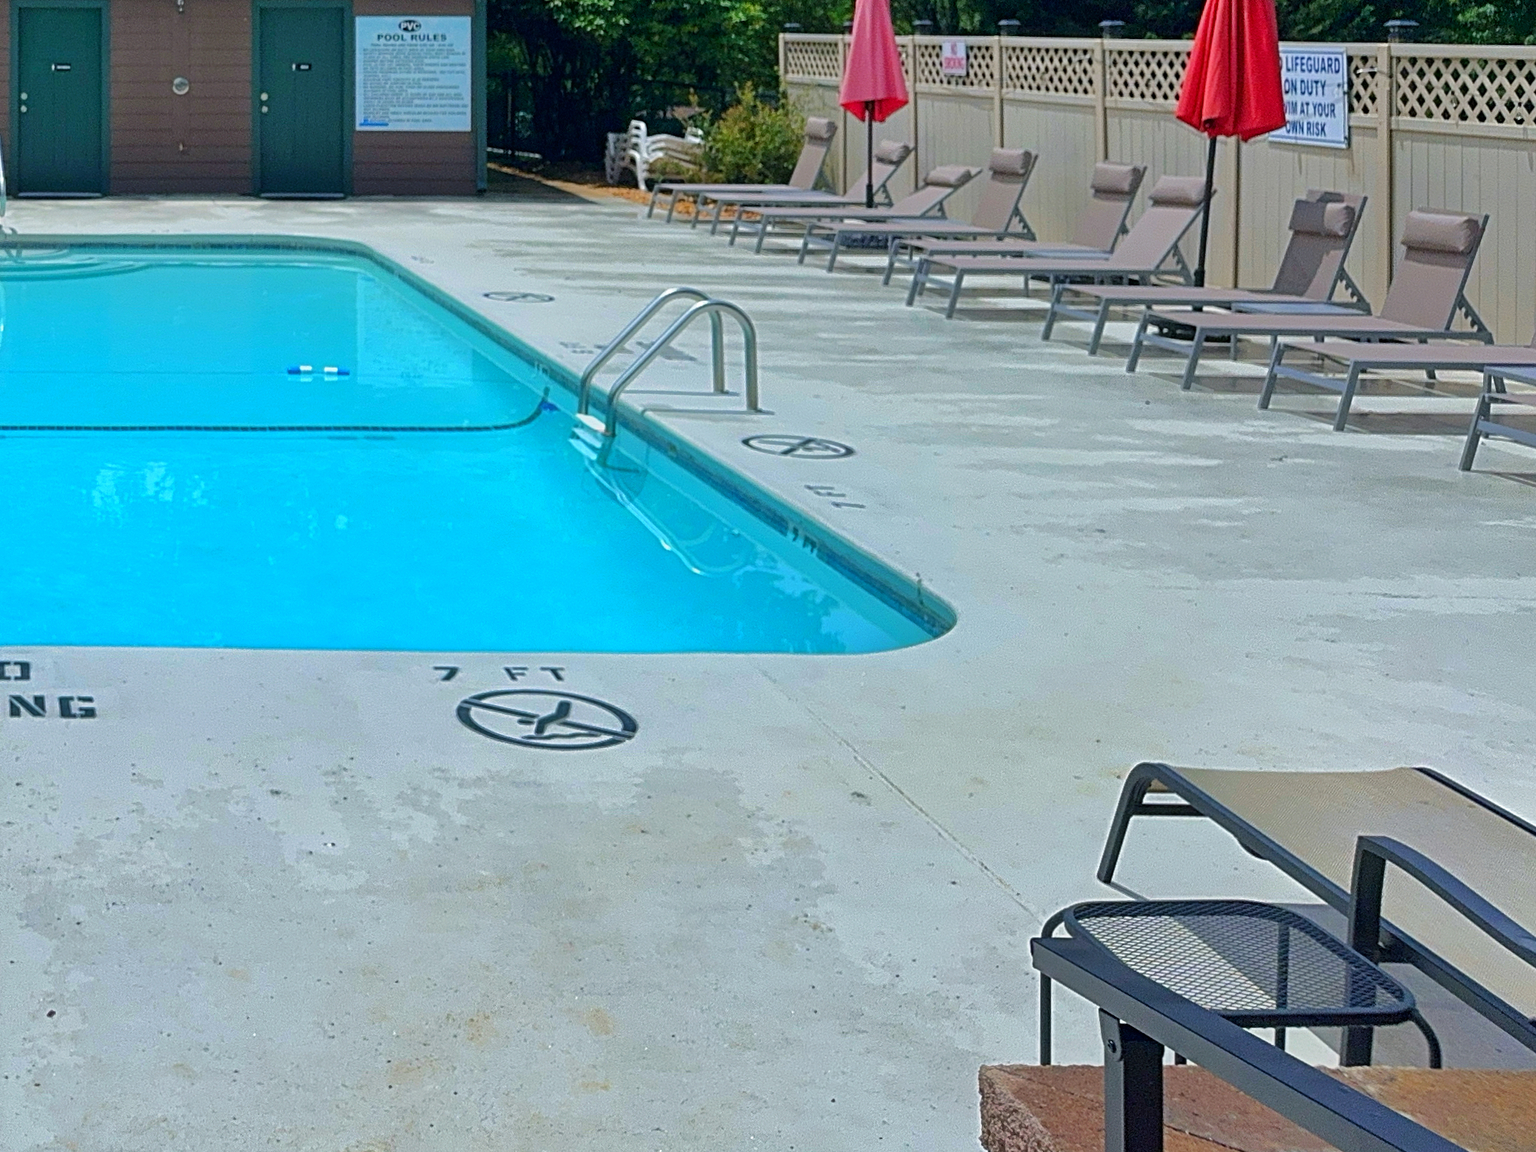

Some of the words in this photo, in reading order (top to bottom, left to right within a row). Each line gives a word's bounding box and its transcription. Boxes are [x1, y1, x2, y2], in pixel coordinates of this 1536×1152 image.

[400, 21, 421, 31] PVC
[377, 33, 407, 42] POOL
[410, 33, 447, 42] RULES
[1285, 55, 1341, 75] LIFEGUARD
[1283, 77, 1298, 96] ON
[1299, 78, 1327, 98] DUTY
[1299, 101, 1310, 117] AT
[1312, 101, 1337, 119] YOUR
[1285, 120, 1305, 136] OWN
[1306, 121, 1327, 138] RISK
[432, 666, 460, 682] 7
[503, 666, 566, 682] FT
